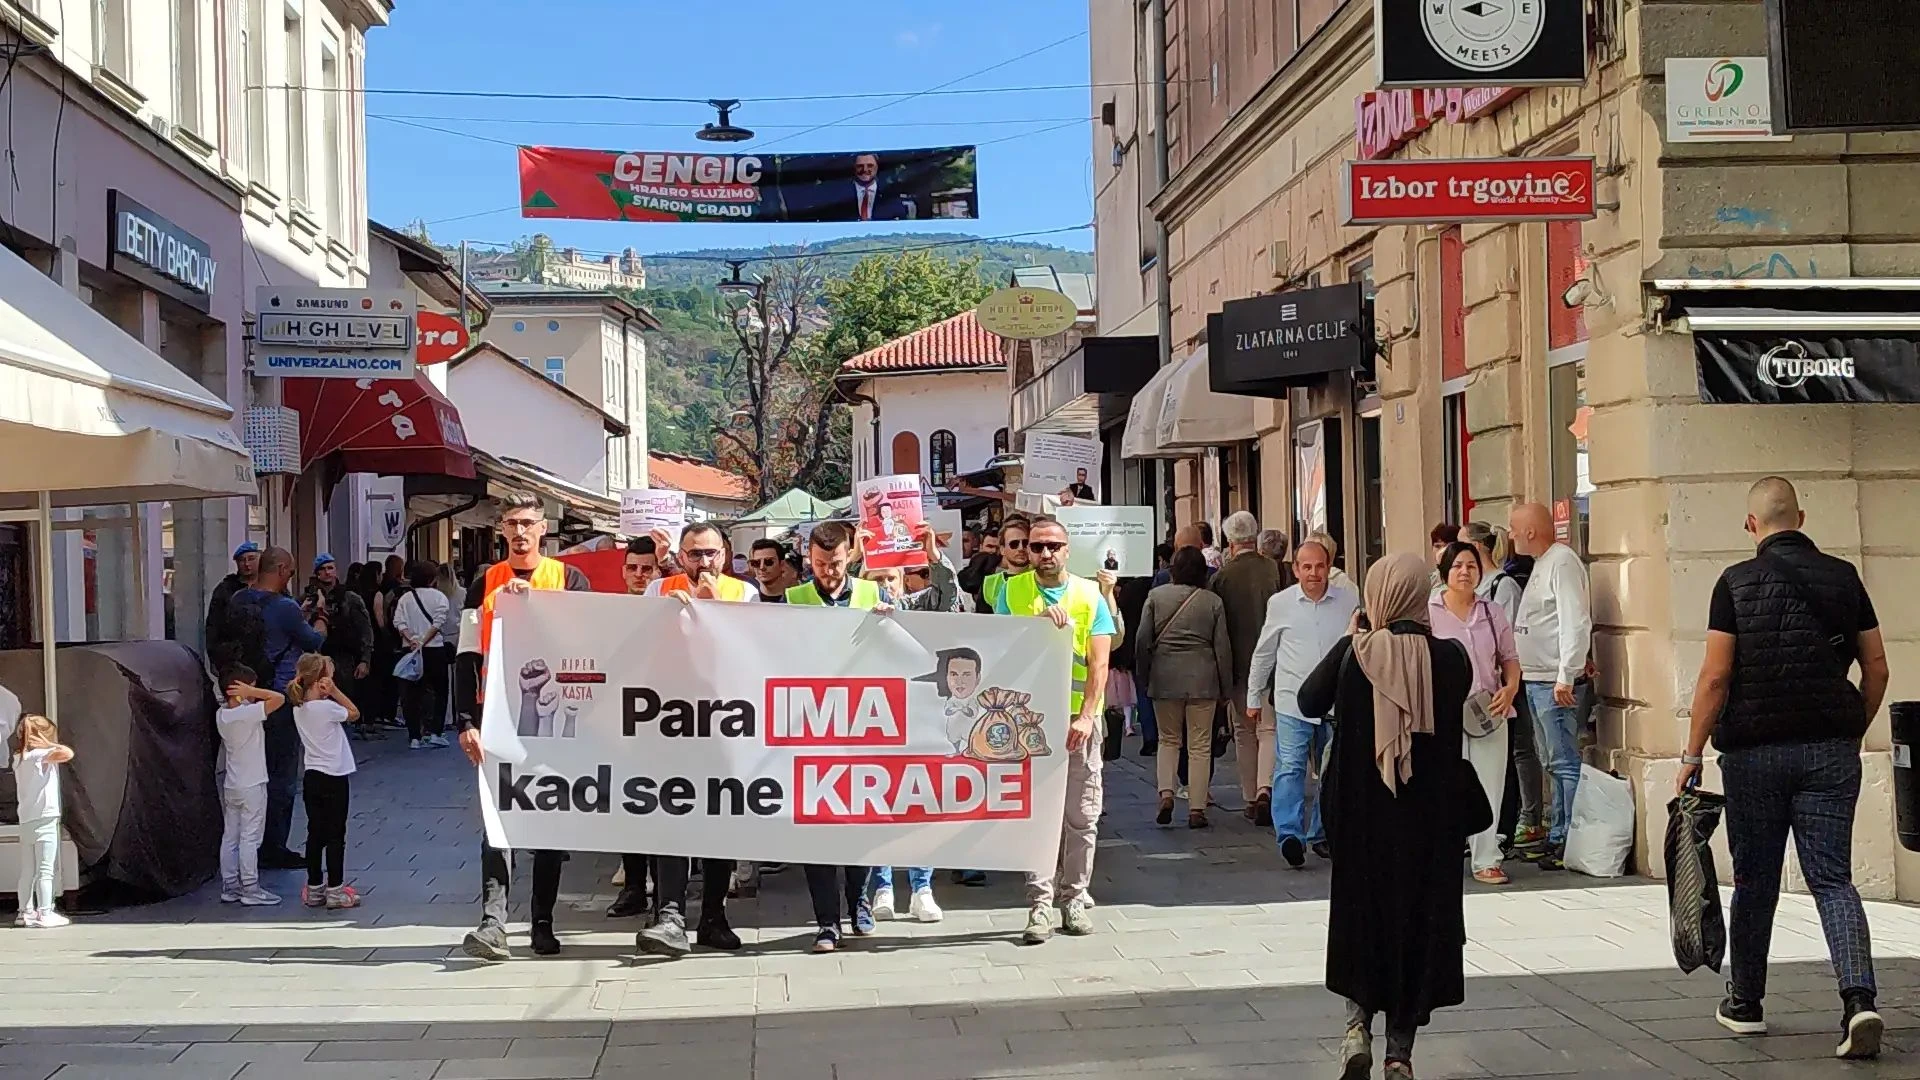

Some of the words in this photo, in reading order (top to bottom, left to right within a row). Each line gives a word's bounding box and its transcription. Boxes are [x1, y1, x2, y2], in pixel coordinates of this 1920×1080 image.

[1456, 43, 1511, 61] MEETS
[1677, 104, 1740, 118] GREEN
[614, 154, 762, 184] CENGIC
[630, 183, 689, 199] HRABRO
[691, 186, 755, 199] SLUŽIMO
[1360, 176, 1438, 199] Izbor
[1449, 172, 1570, 204] trgovine
[632, 194, 693, 213] STAROM
[697, 203, 752, 218] GRADU
[125, 212, 166, 270] BETTY
[167, 235, 218, 296] BARCLAY
[296, 298, 349, 309] SAMSUNG
[287, 320, 340, 338] HIGH
[346, 321, 403, 339] LEVEL
[1236, 326, 1305, 350] ZLATARNA
[1307, 320, 1348, 341] CELJE
[268, 356, 402, 371] UNIVERZALNO.COM
[1772, 357, 1856, 379] TUBORG
[561, 659, 595, 671] HIPER
[561, 686, 593, 700] KASTA
[622, 688, 756, 737] Para
[773, 687, 900, 738] IMA
[499, 763, 611, 813] kad
[623, 776, 696, 815] se
[708, 777, 783, 816] ne
[803, 765, 1023, 816] KRADE
